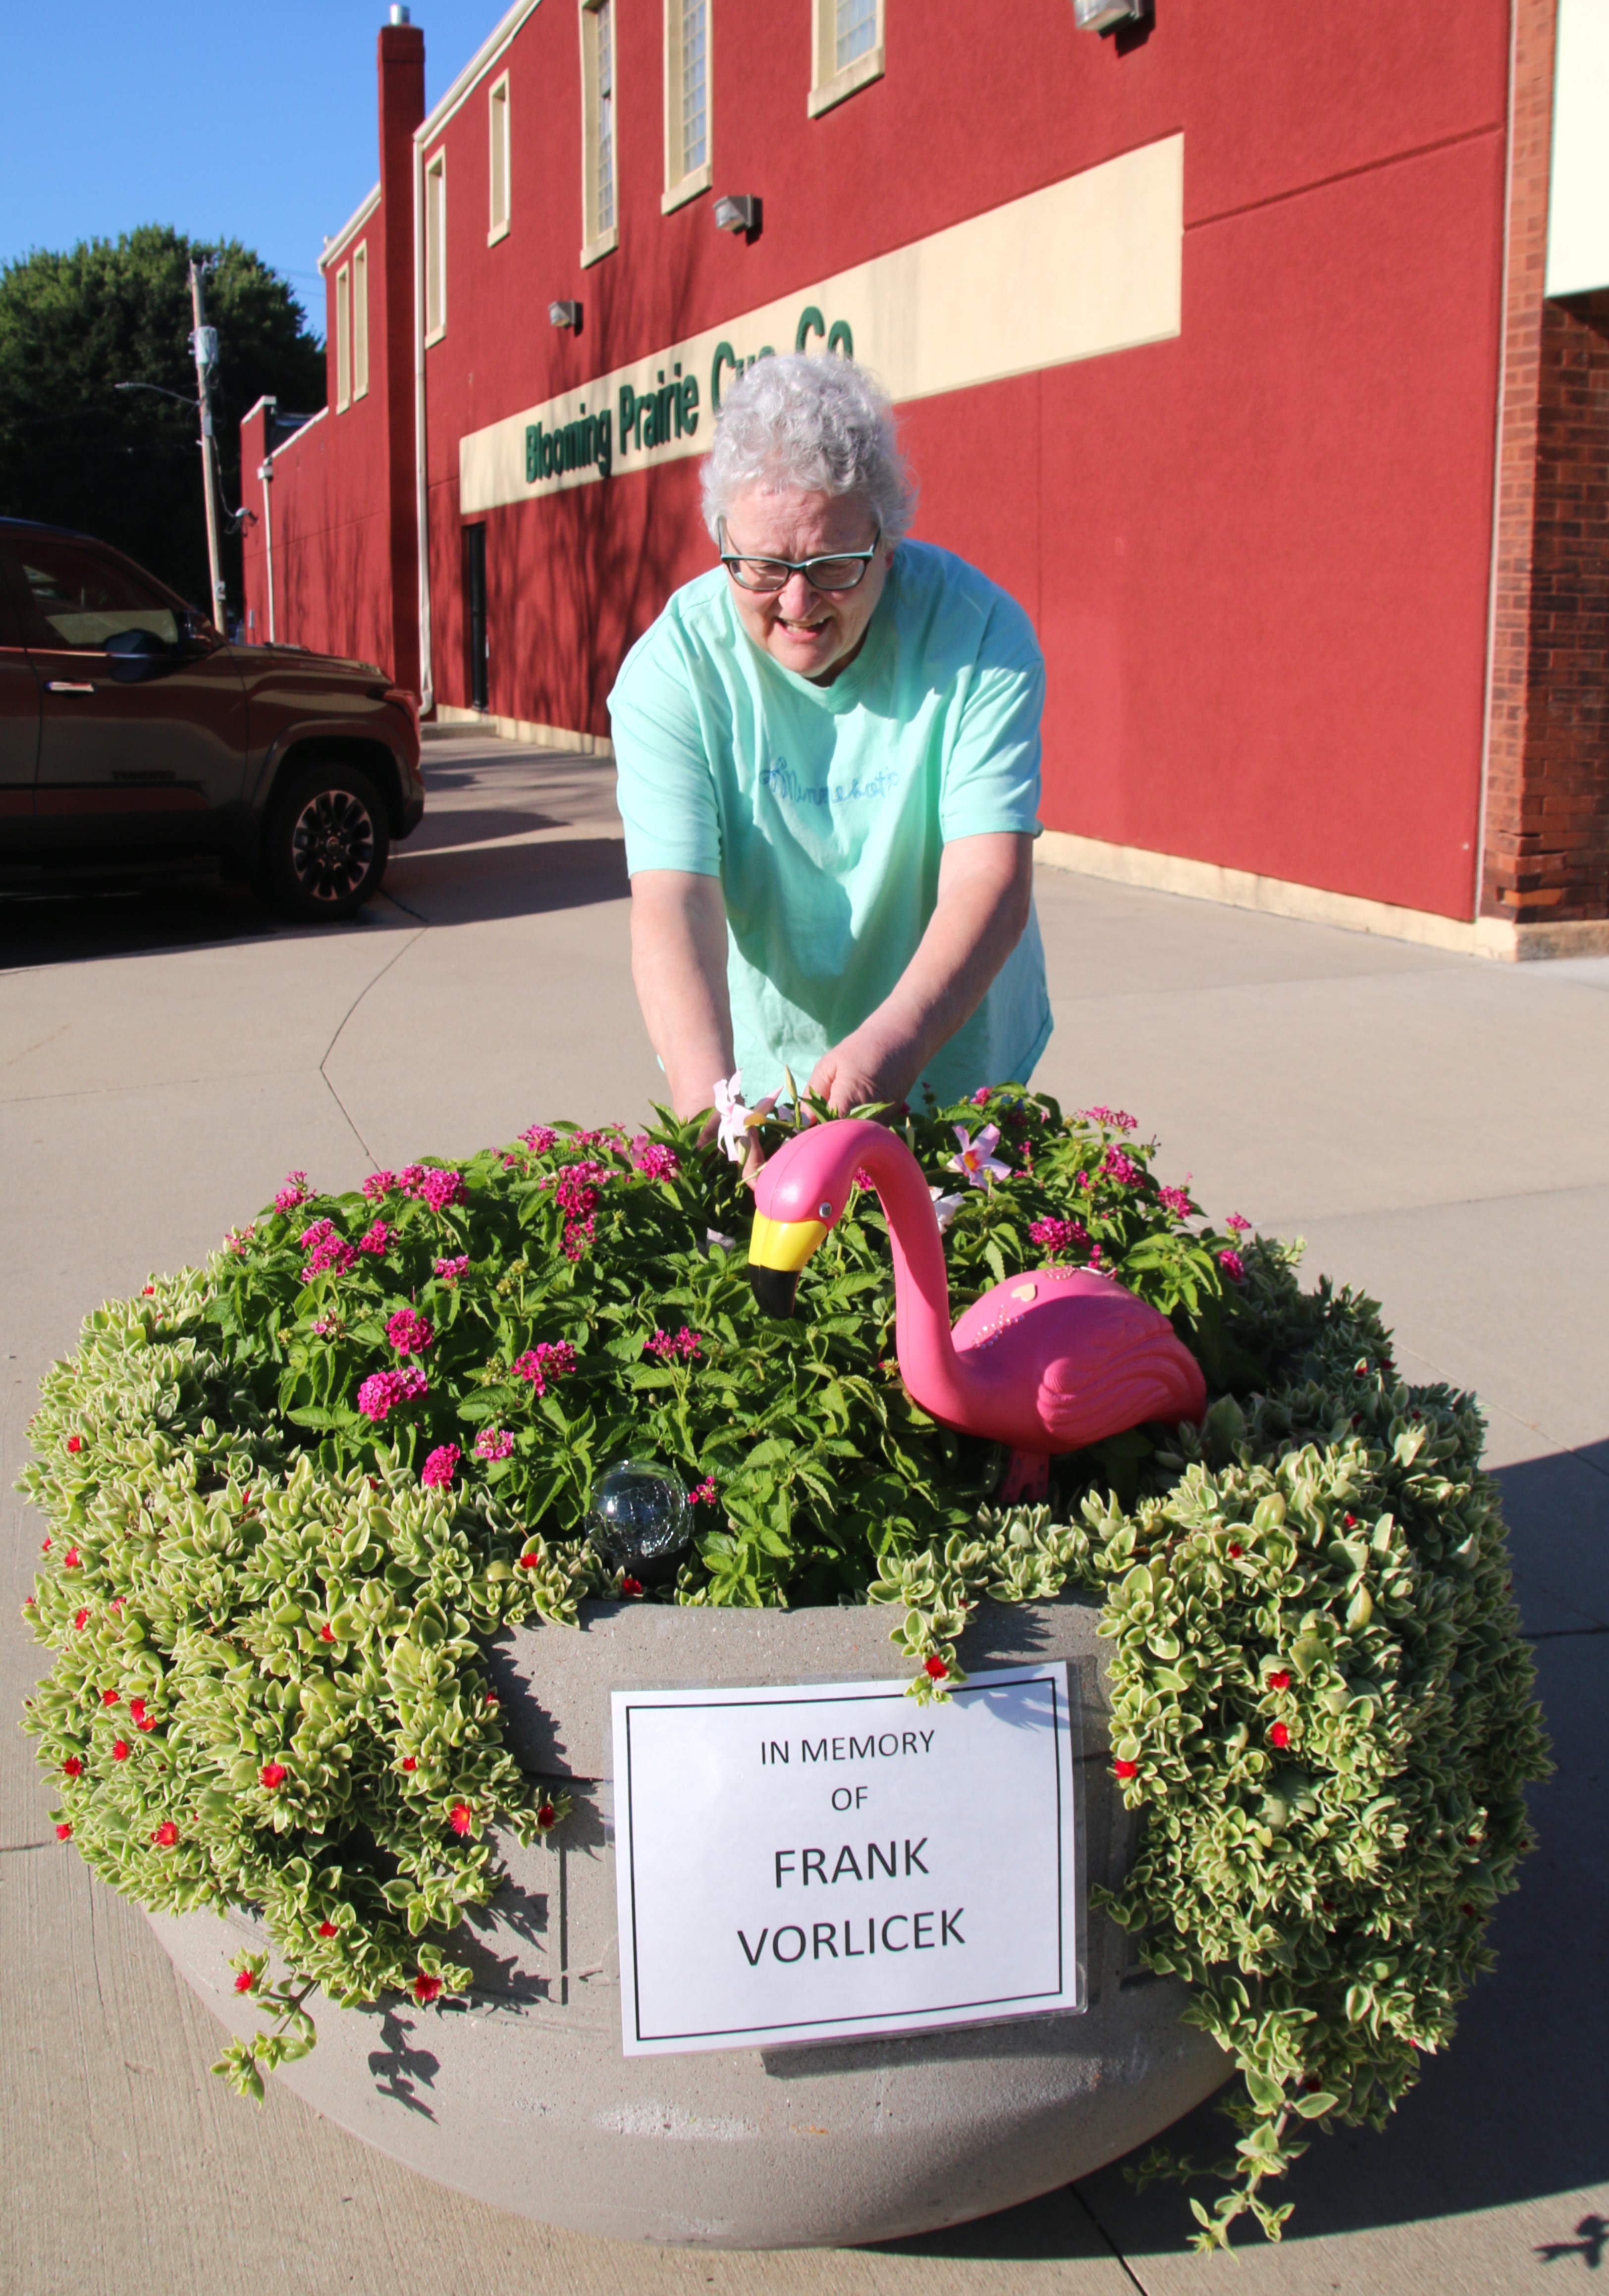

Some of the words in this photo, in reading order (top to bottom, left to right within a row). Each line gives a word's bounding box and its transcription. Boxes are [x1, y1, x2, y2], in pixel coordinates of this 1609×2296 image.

[526, 402, 612, 483] Blooming
[619, 362, 699, 456] Prairie
[761, 1740, 790, 1766] IN
[801, 1729, 935, 1763] MEMORY
[831, 1785, 868, 1812] OF
[775, 1836, 930, 1889] FRANK
[737, 1907, 966, 1967] VORLICEK
